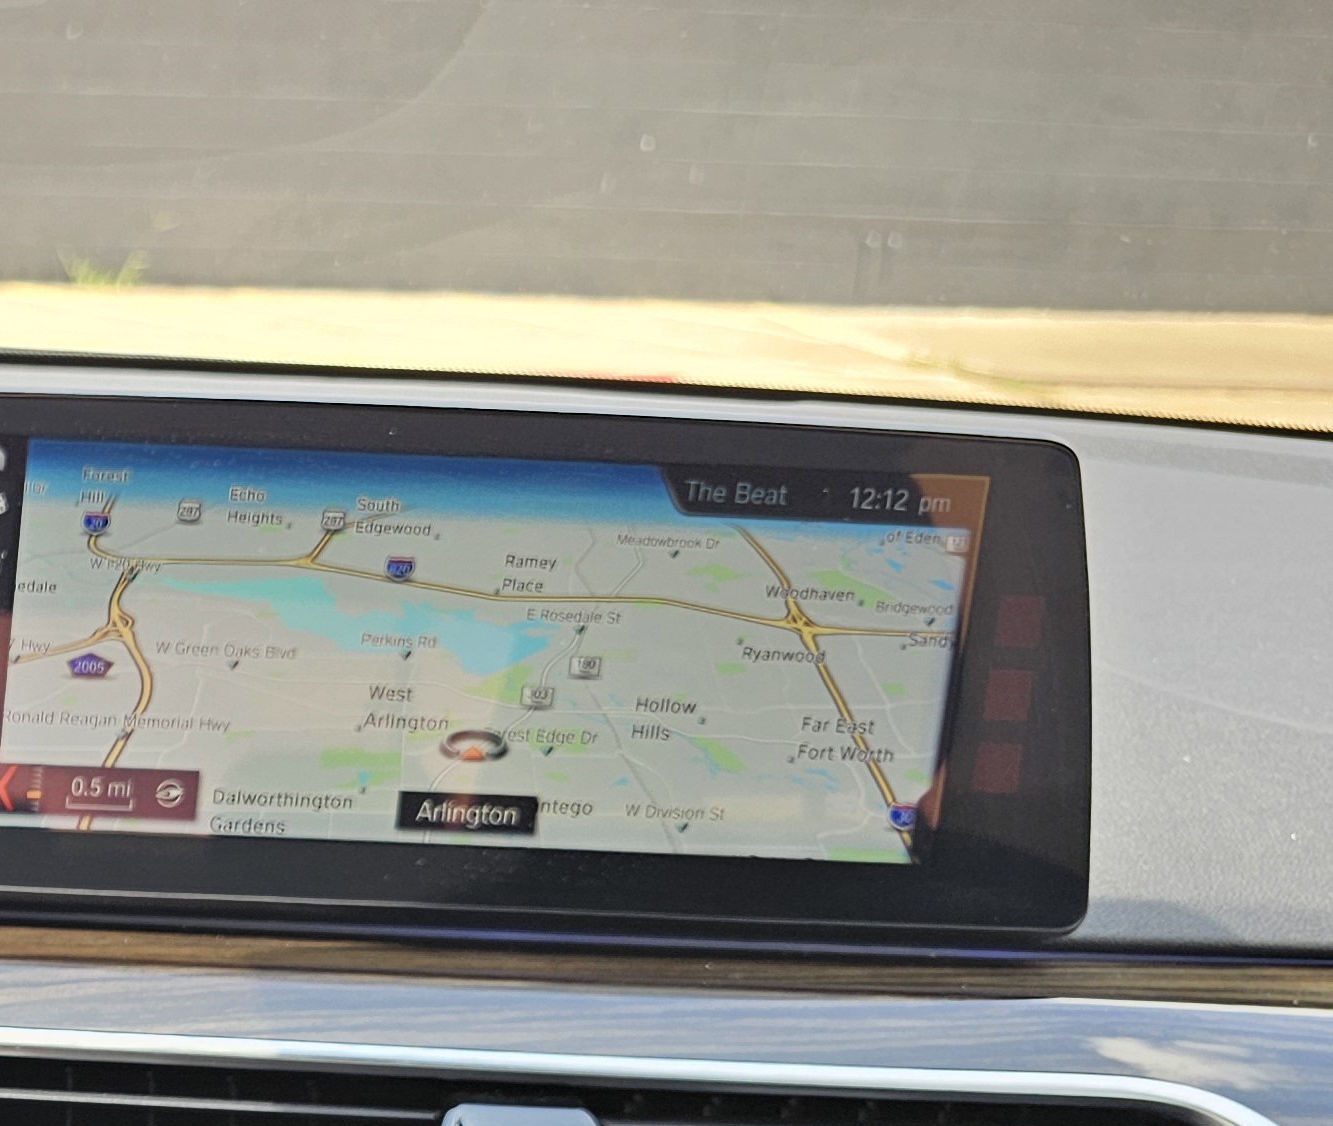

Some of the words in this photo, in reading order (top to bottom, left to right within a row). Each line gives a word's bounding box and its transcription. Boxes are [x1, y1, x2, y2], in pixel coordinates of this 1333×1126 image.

[79, 491, 104, 503] Hill
[229, 487, 265, 502] Echo
[686, 479, 726, 504] The
[735, 482, 788, 507] Beat
[849, 486, 908, 512] 12:12
[918, 498, 952, 516] pm
[357, 498, 400, 513] South
[227, 510, 284, 527] Heights
[355, 520, 431, 537] Edgewood
[617, 533, 699, 550] Meadowbrook
[702, 538, 720, 550] Dr
[886, 530, 902, 543] of
[905, 531, 942, 546] Eden
[505, 554, 557, 572] Ramey
[501, 578, 544, 593] Place
[765, 585, 855, 601] Woodhaven
[527, 608, 535, 620] E
[540, 608, 603, 624] Rosedale
[606, 611, 621, 625] St
[874, 600, 954, 617] Bridgewood
[21, 637, 52, 656] Hwy
[361, 632, 413, 648] Perkins
[417, 635, 437, 648] Rd
[156, 641, 169, 653] W
[175, 642, 219, 656] Green
[225, 643, 260, 658] Oaks
[742, 646, 826, 665] Ryanwood
[73, 659, 105, 674] 2005
[369, 685, 413, 702] West
[635, 696, 697, 715] Hollow
[3, 709, 55, 725] Ronald
[60, 711, 117, 729] Reagan
[123, 714, 193, 730] Memorial
[199, 717, 232, 733] Hwy
[363, 712, 449, 734] Arlington
[801, 716, 830, 734] Far
[835, 717, 874, 736] East
[536, 729, 575, 747] Edge
[580, 730, 598, 745] Dr
[631, 724, 670, 741] Hills
[797, 743, 833, 761] Fort
[839, 745, 894, 763] Worth
[71, 776, 101, 797] 0.5
[107, 778, 132, 797] mi
[211, 788, 353, 811] Dalworthington
[415, 798, 520, 830] Arlington
[625, 803, 641, 817] W
[644, 804, 705, 821] Division
[708, 806, 725, 821] St
[209, 815, 286, 835] Gardens
